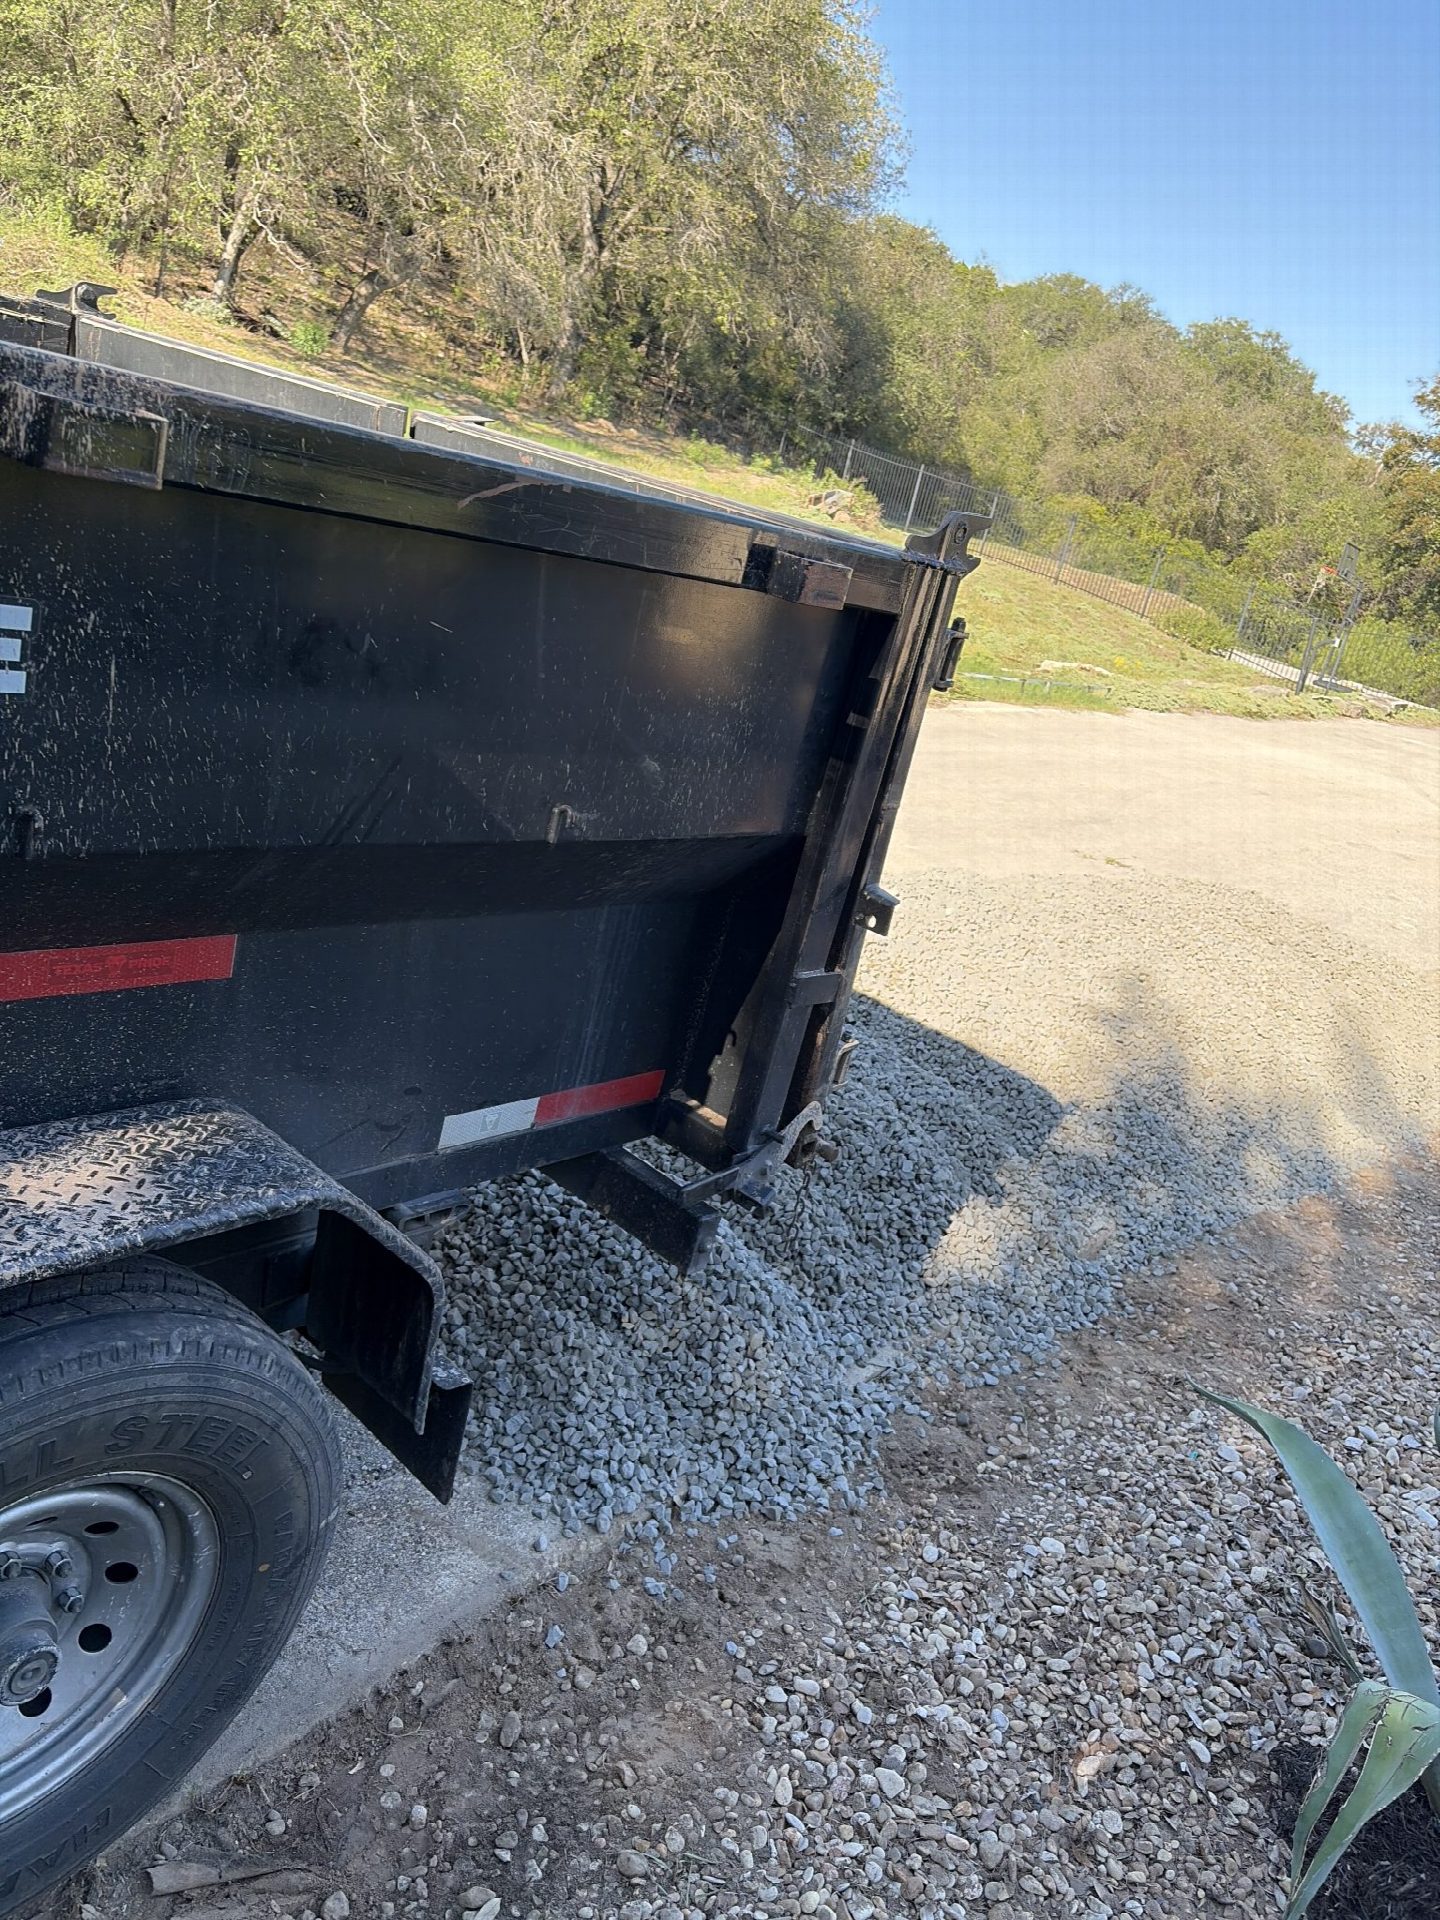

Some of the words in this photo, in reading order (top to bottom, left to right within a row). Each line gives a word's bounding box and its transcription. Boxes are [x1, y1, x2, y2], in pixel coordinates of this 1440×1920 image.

[53, 962, 103, 977] TEXAS
[127, 955, 170, 970] PRIDE
[103, 1412, 271, 1479] STEEL
